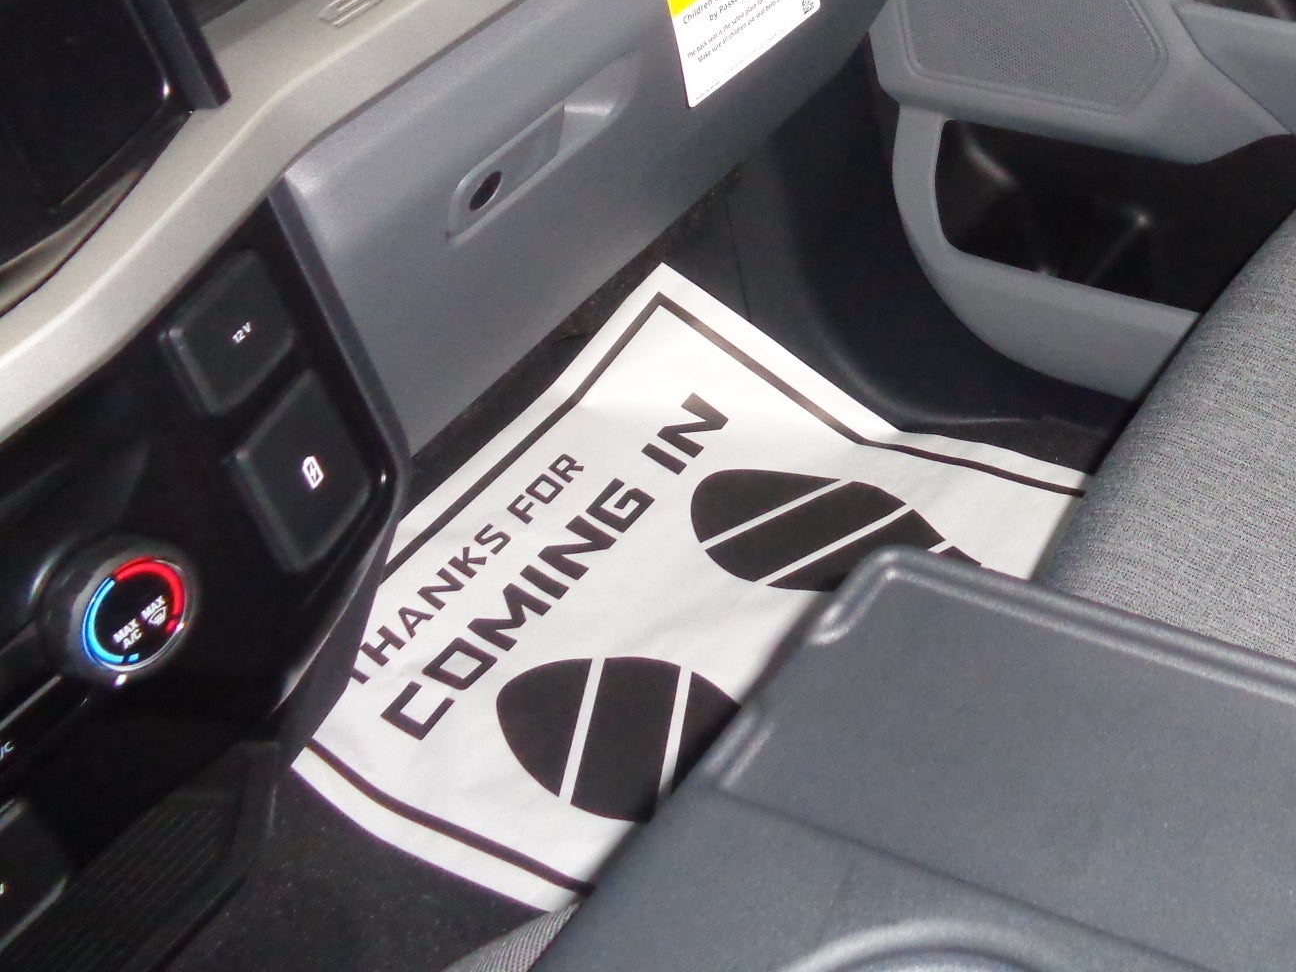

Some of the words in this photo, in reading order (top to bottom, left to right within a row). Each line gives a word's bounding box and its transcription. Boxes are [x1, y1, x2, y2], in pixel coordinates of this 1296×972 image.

[709, 11, 718, 21] by
[506, 453, 585, 525] FOR
[380, 478, 655, 741] COMING
[641, 392, 729, 476] IN
[141, 595, 166, 621] MAX
[113, 618, 140, 643] MAX
[123, 628, 142, 649] A/C
